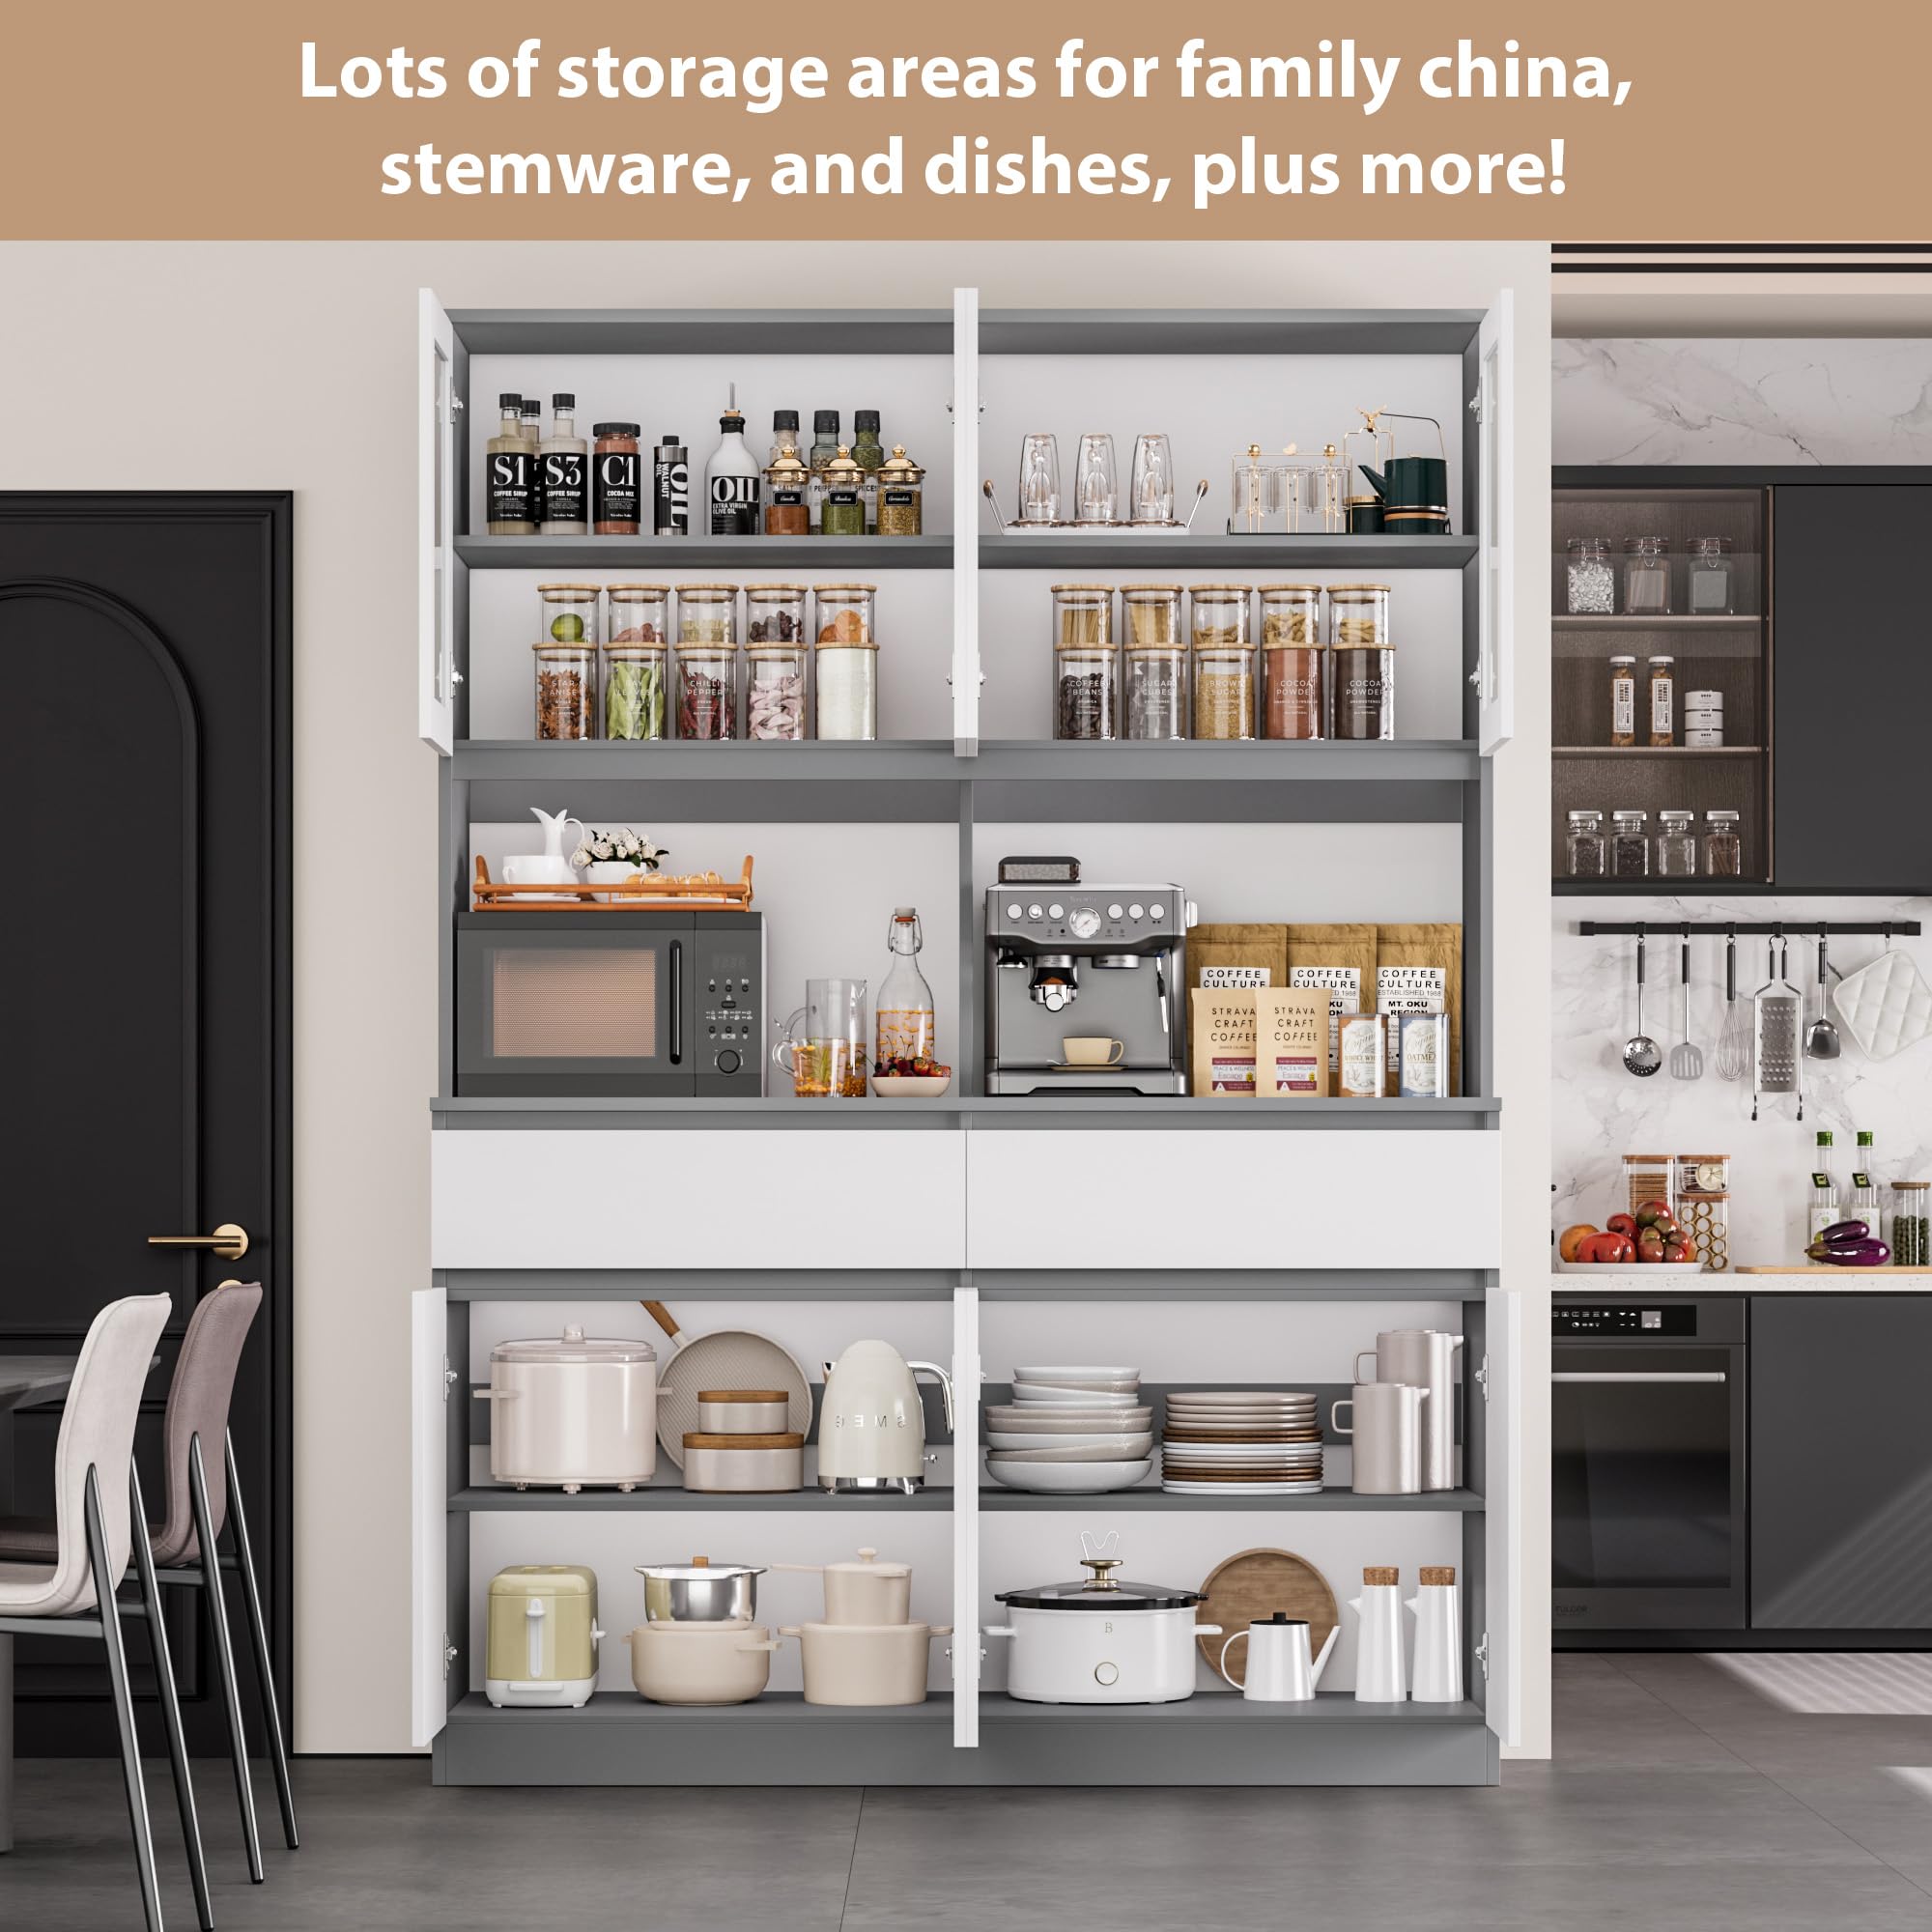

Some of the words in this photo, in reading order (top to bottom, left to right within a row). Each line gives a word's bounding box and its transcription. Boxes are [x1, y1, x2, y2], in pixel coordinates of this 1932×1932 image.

[493, 455, 527, 487] S1
[545, 455, 582, 486] S3
[602, 455, 637, 487] C1
[661, 463, 669, 498] WALNUT
[712, 477, 759, 503] OIL
[1207, 969, 1261, 978] COFFEE
[1297, 969, 1351, 979] COFFEE
[1382, 969, 1436, 979] COFFEE
[1214, 1019, 1253, 1028] CRAFT
[1210, 1033, 1256, 1041] COFFEE
